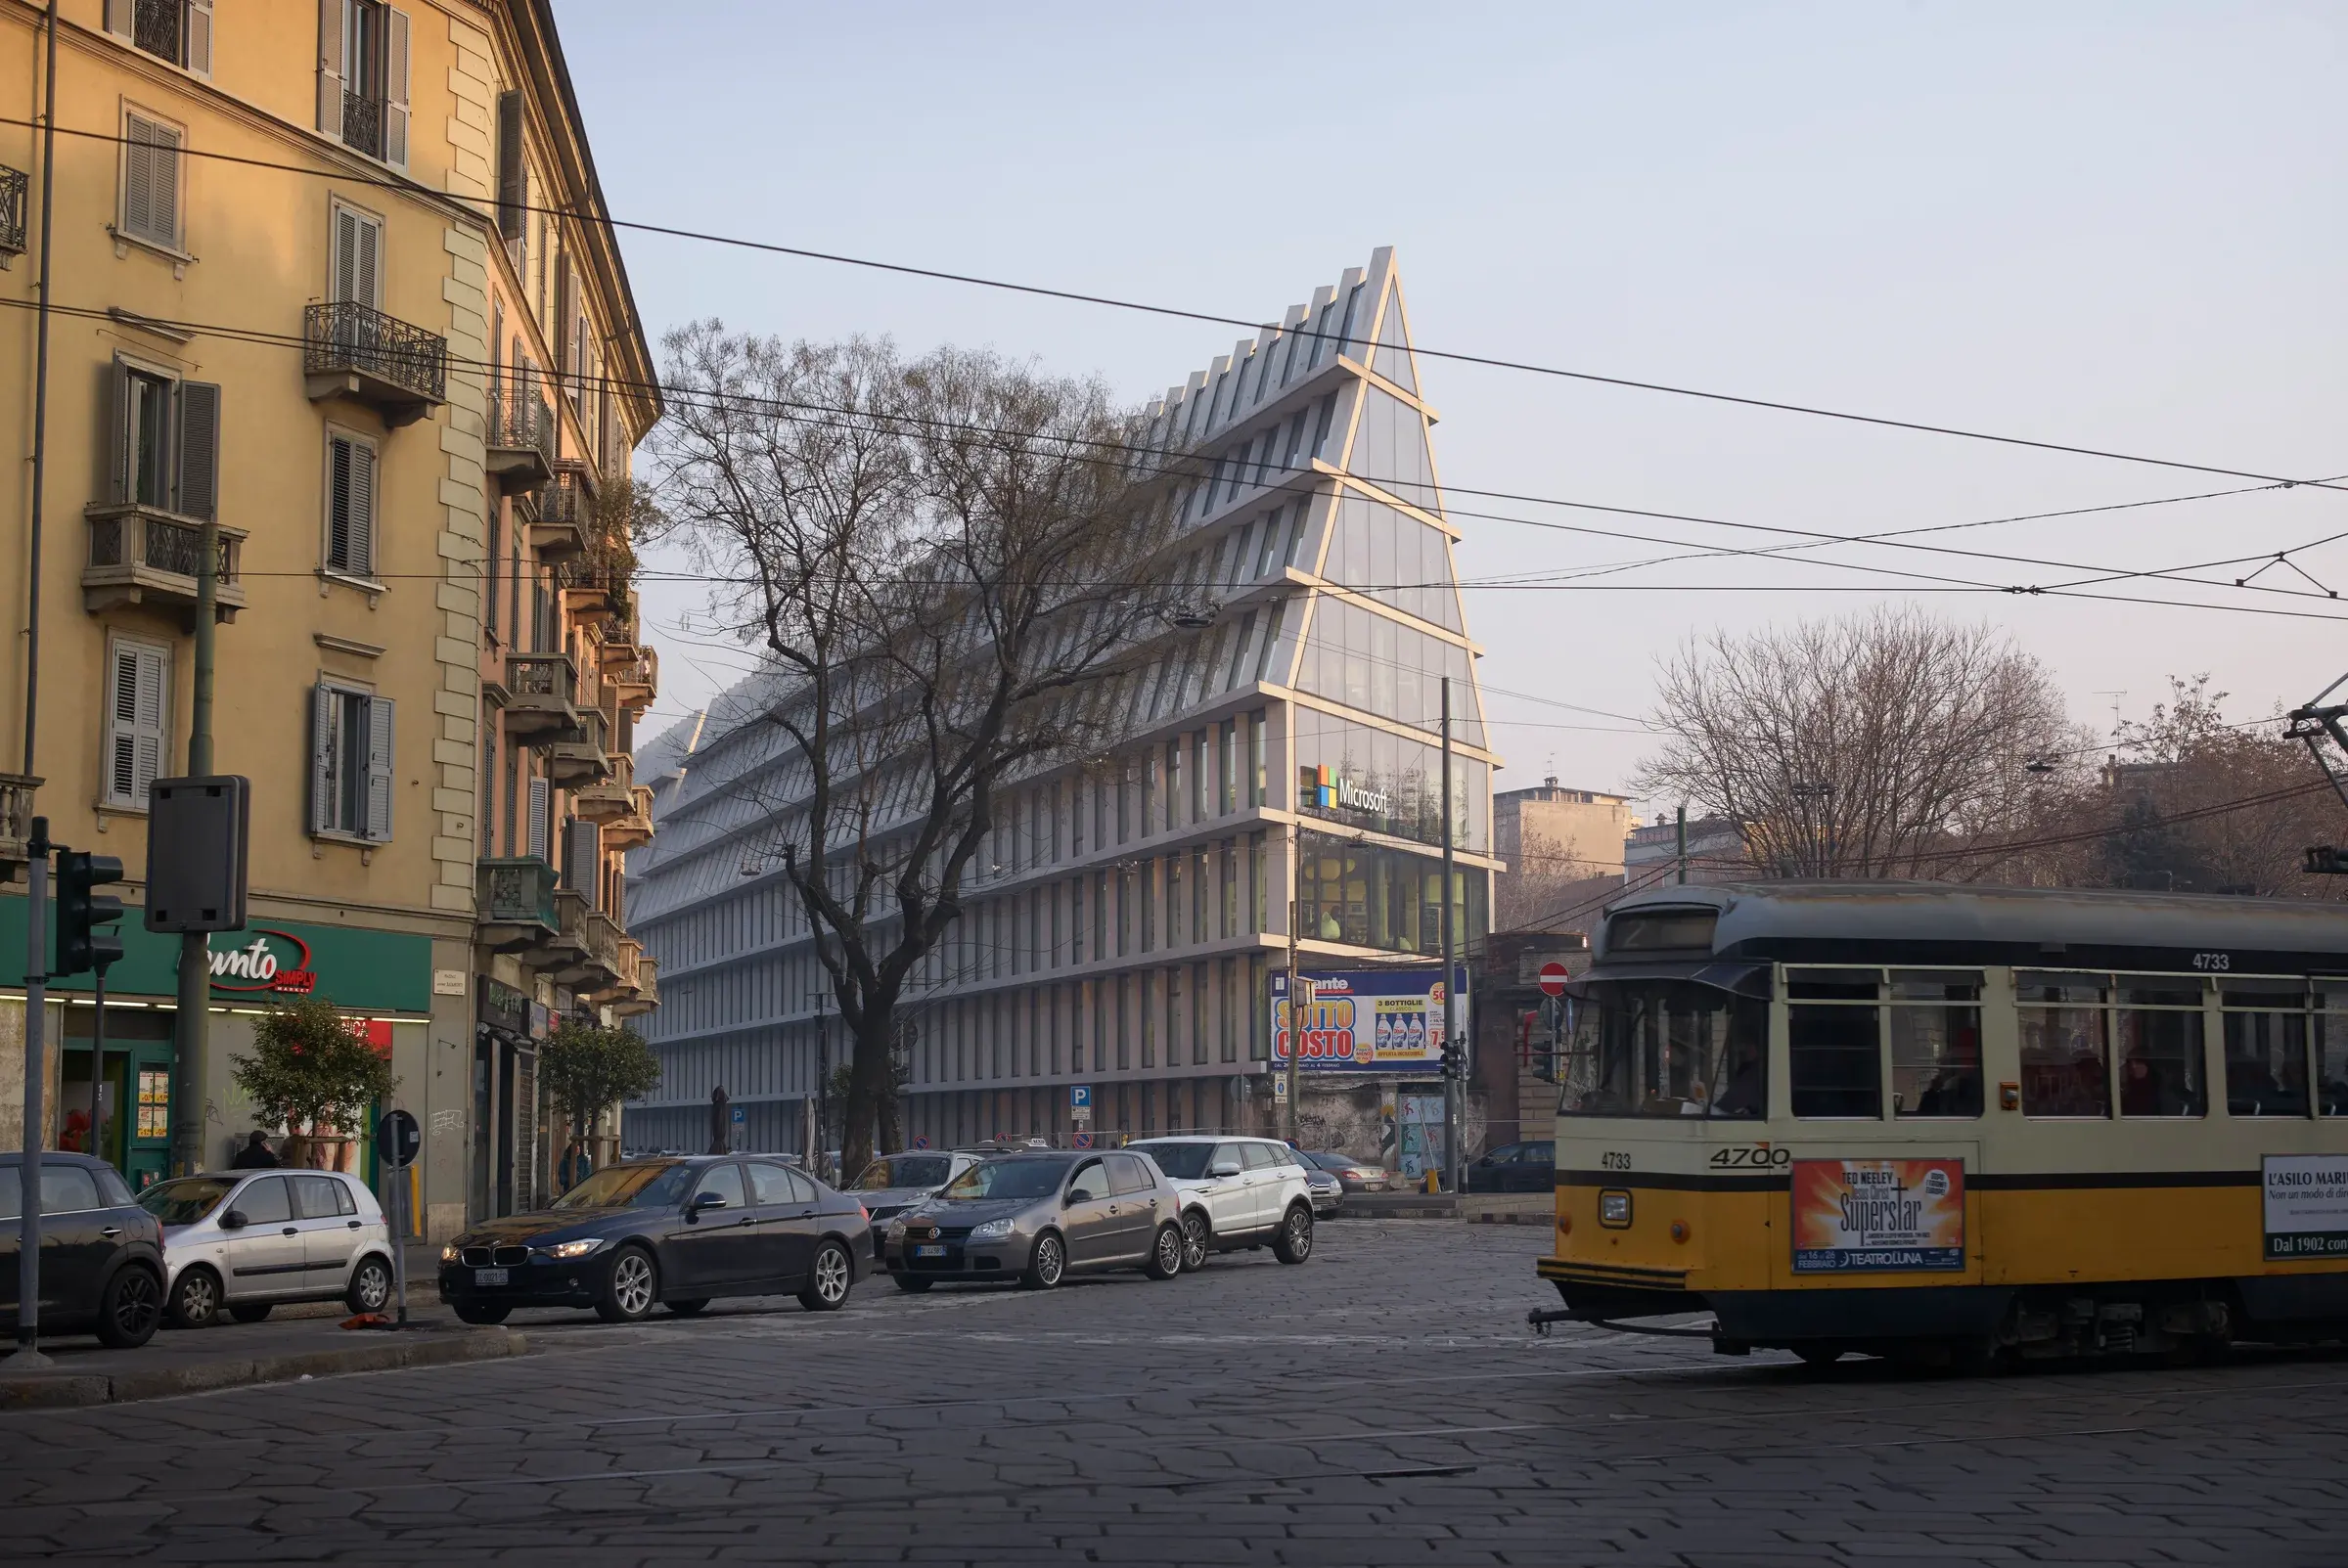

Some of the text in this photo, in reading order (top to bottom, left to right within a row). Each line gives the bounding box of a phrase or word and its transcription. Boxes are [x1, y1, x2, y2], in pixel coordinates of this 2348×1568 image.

[1339, 778, 1387, 813] Microsoft
[205, 932, 277, 979] unto
[2192, 954, 2230, 969] 4733
[1315, 977, 1348, 990] ante
[1278, 1000, 1353, 1028] SOTTO
[1278, 1030, 1352, 1057] COSTO
[1602, 1151, 1632, 1170] 4733
[1710, 1148, 1790, 1165] 4700
[1842, 1172, 1894, 1185] TED NEELEY
[2268, 1172, 2312, 1186] L'ASILO
[1849, 1185, 1889, 1200] Jesus Christ
[2269, 1189, 2286, 1200] Non
[2287, 1190, 2299, 1199] un
[2301, 1187, 2325, 1199] modo
[2326, 1187, 2334, 1198] di
[1840, 1184, 1921, 1246] Superstar
[2274, 1236, 2293, 1252] Dal
[2297, 1236, 2325, 1251] 1902
[1808, 1250, 1818, 1260] 16
[1826, 1250, 1835, 1260] 26
[1797, 1259, 1836, 1269] FEBBRAIO
